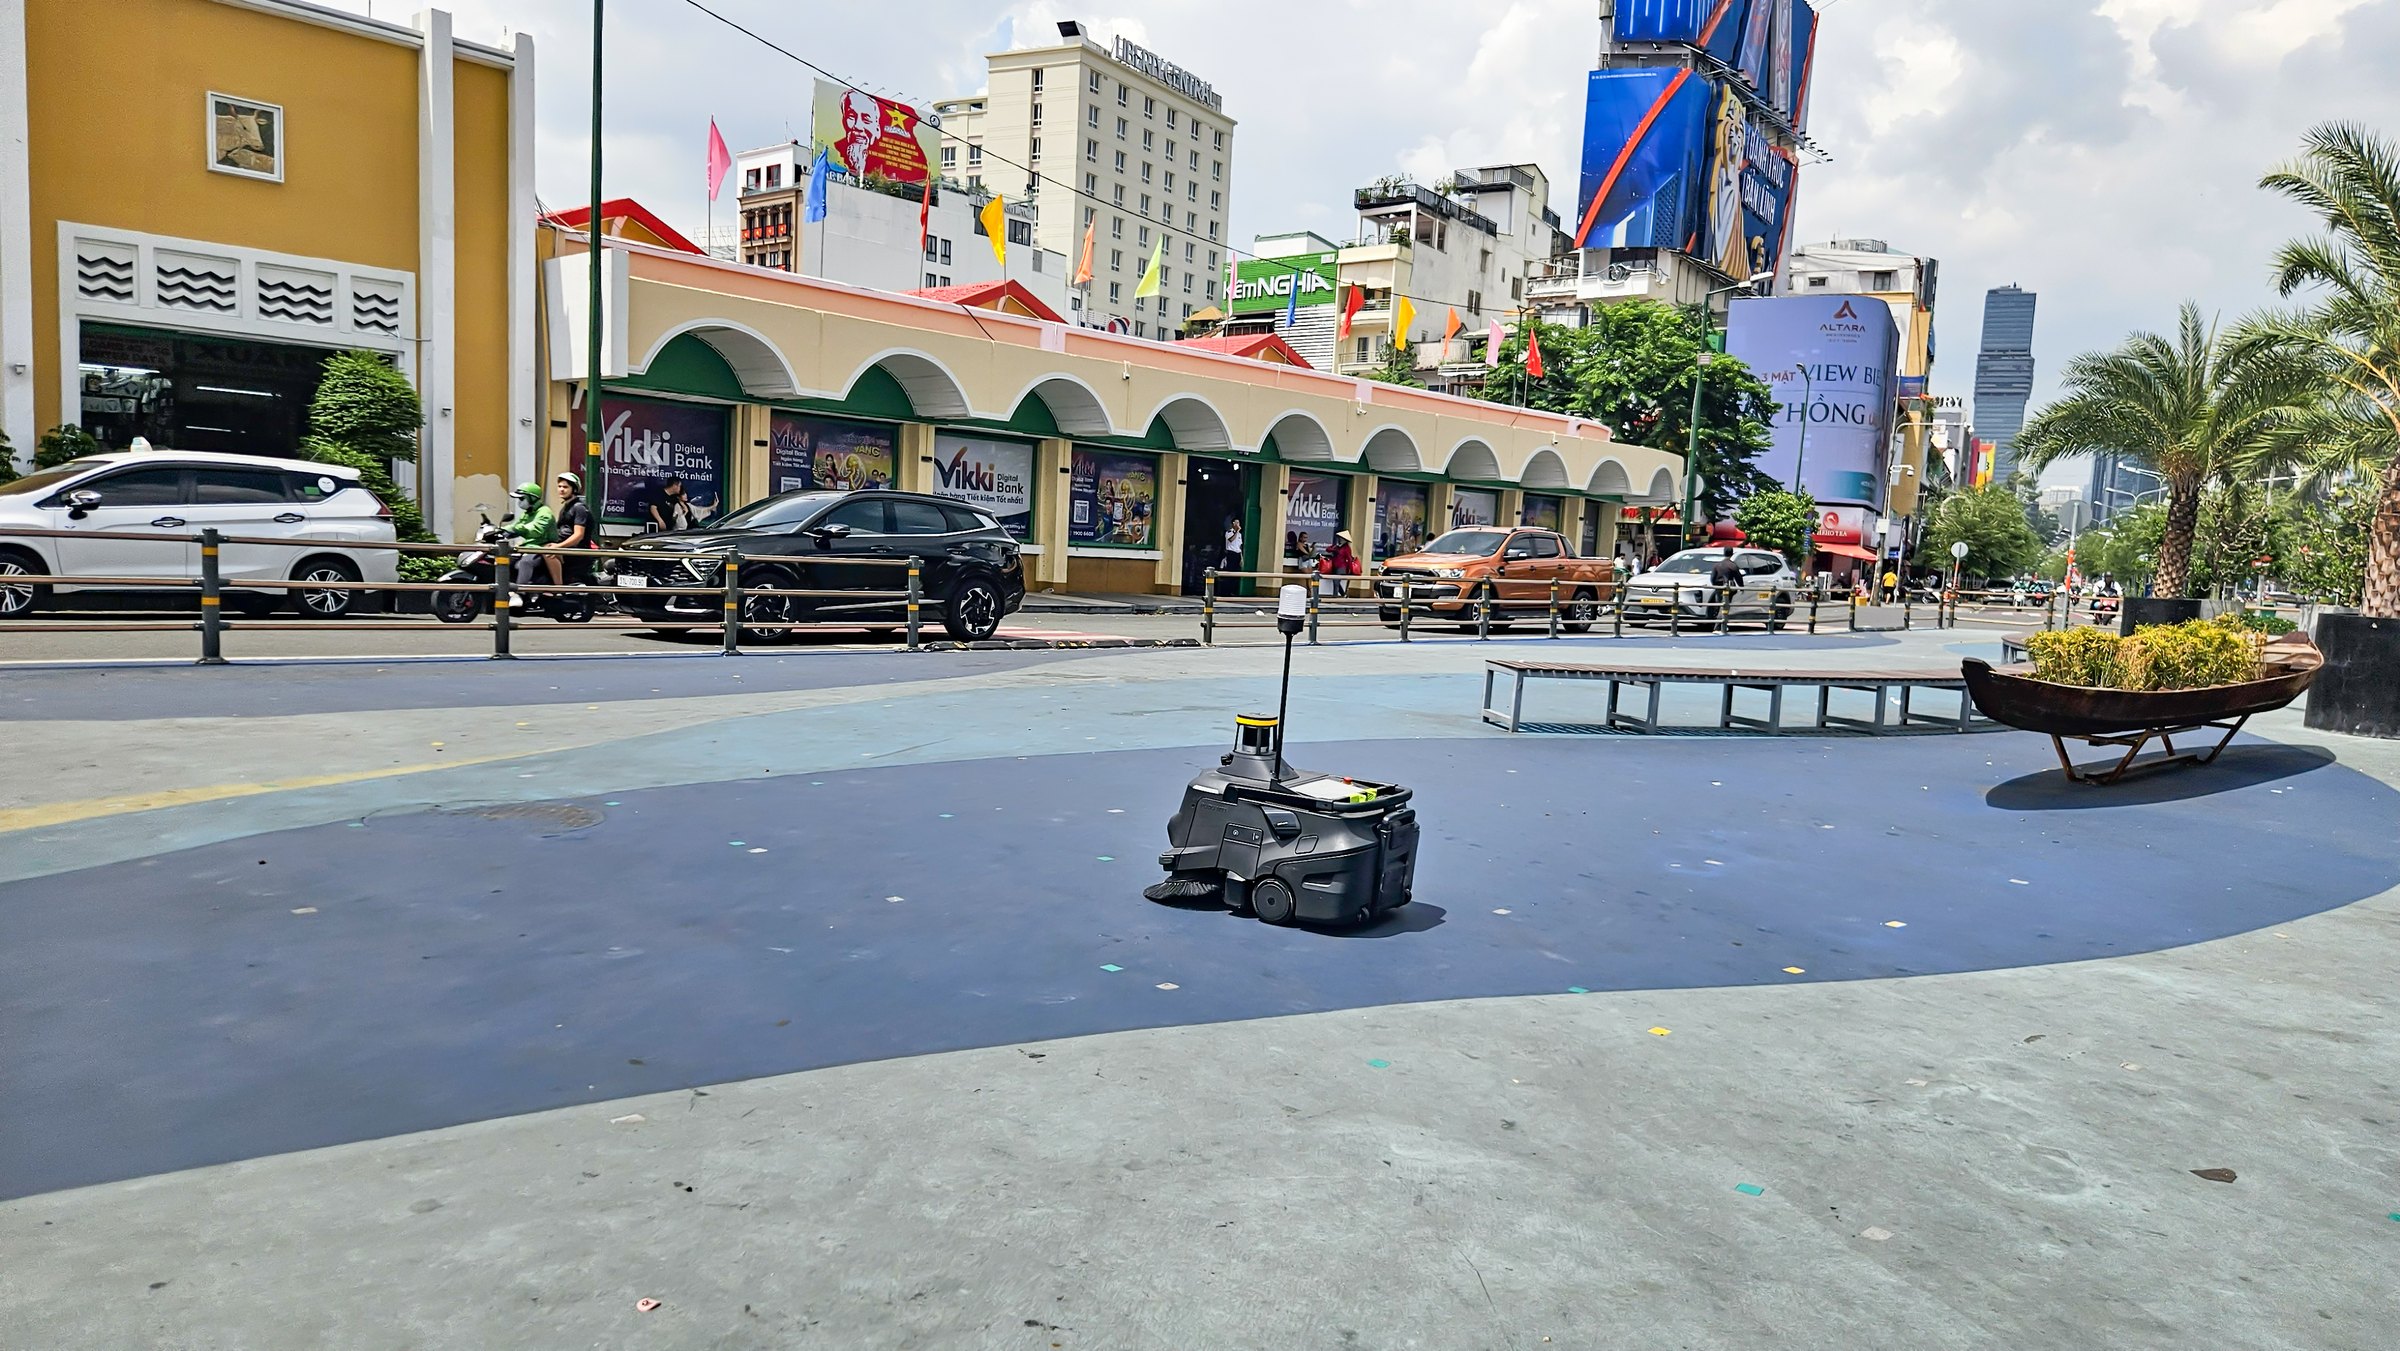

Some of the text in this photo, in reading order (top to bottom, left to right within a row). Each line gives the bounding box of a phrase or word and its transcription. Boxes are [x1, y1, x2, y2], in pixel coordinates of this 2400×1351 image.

[1115, 34, 1214, 107] LIBERTY CENTRAL
[1256, 266, 1333, 297] NGHĨA
[1819, 323, 1866, 333] ALTARA
[1761, 373, 1769, 383] 3
[1771, 369, 1796, 384] MẶT
[1805, 364, 1858, 382] VIEW
[581, 410, 671, 467] Vikki
[771, 422, 809, 450] Vikki
[675, 443, 705, 455] Digital
[775, 448, 808, 458] Digital Bank
[674, 453, 713, 470] Bank
[934, 446, 995, 492] Vikki
[674, 469, 689, 480] Tốt
[691, 471, 713, 482] nhất!
[997, 473, 1018, 482] Digital
[996, 482, 1024, 495] Bank
[949, 492, 966, 501] hàng
[966, 493, 980, 502] Tiết
[980, 493, 995, 503] kiệm
[996, 495, 1007, 504] Tốt
[1287, 482, 1321, 518] Vikki
[1321, 509, 1339, 519] Bank
[1451, 496, 1476, 526] Vikki
